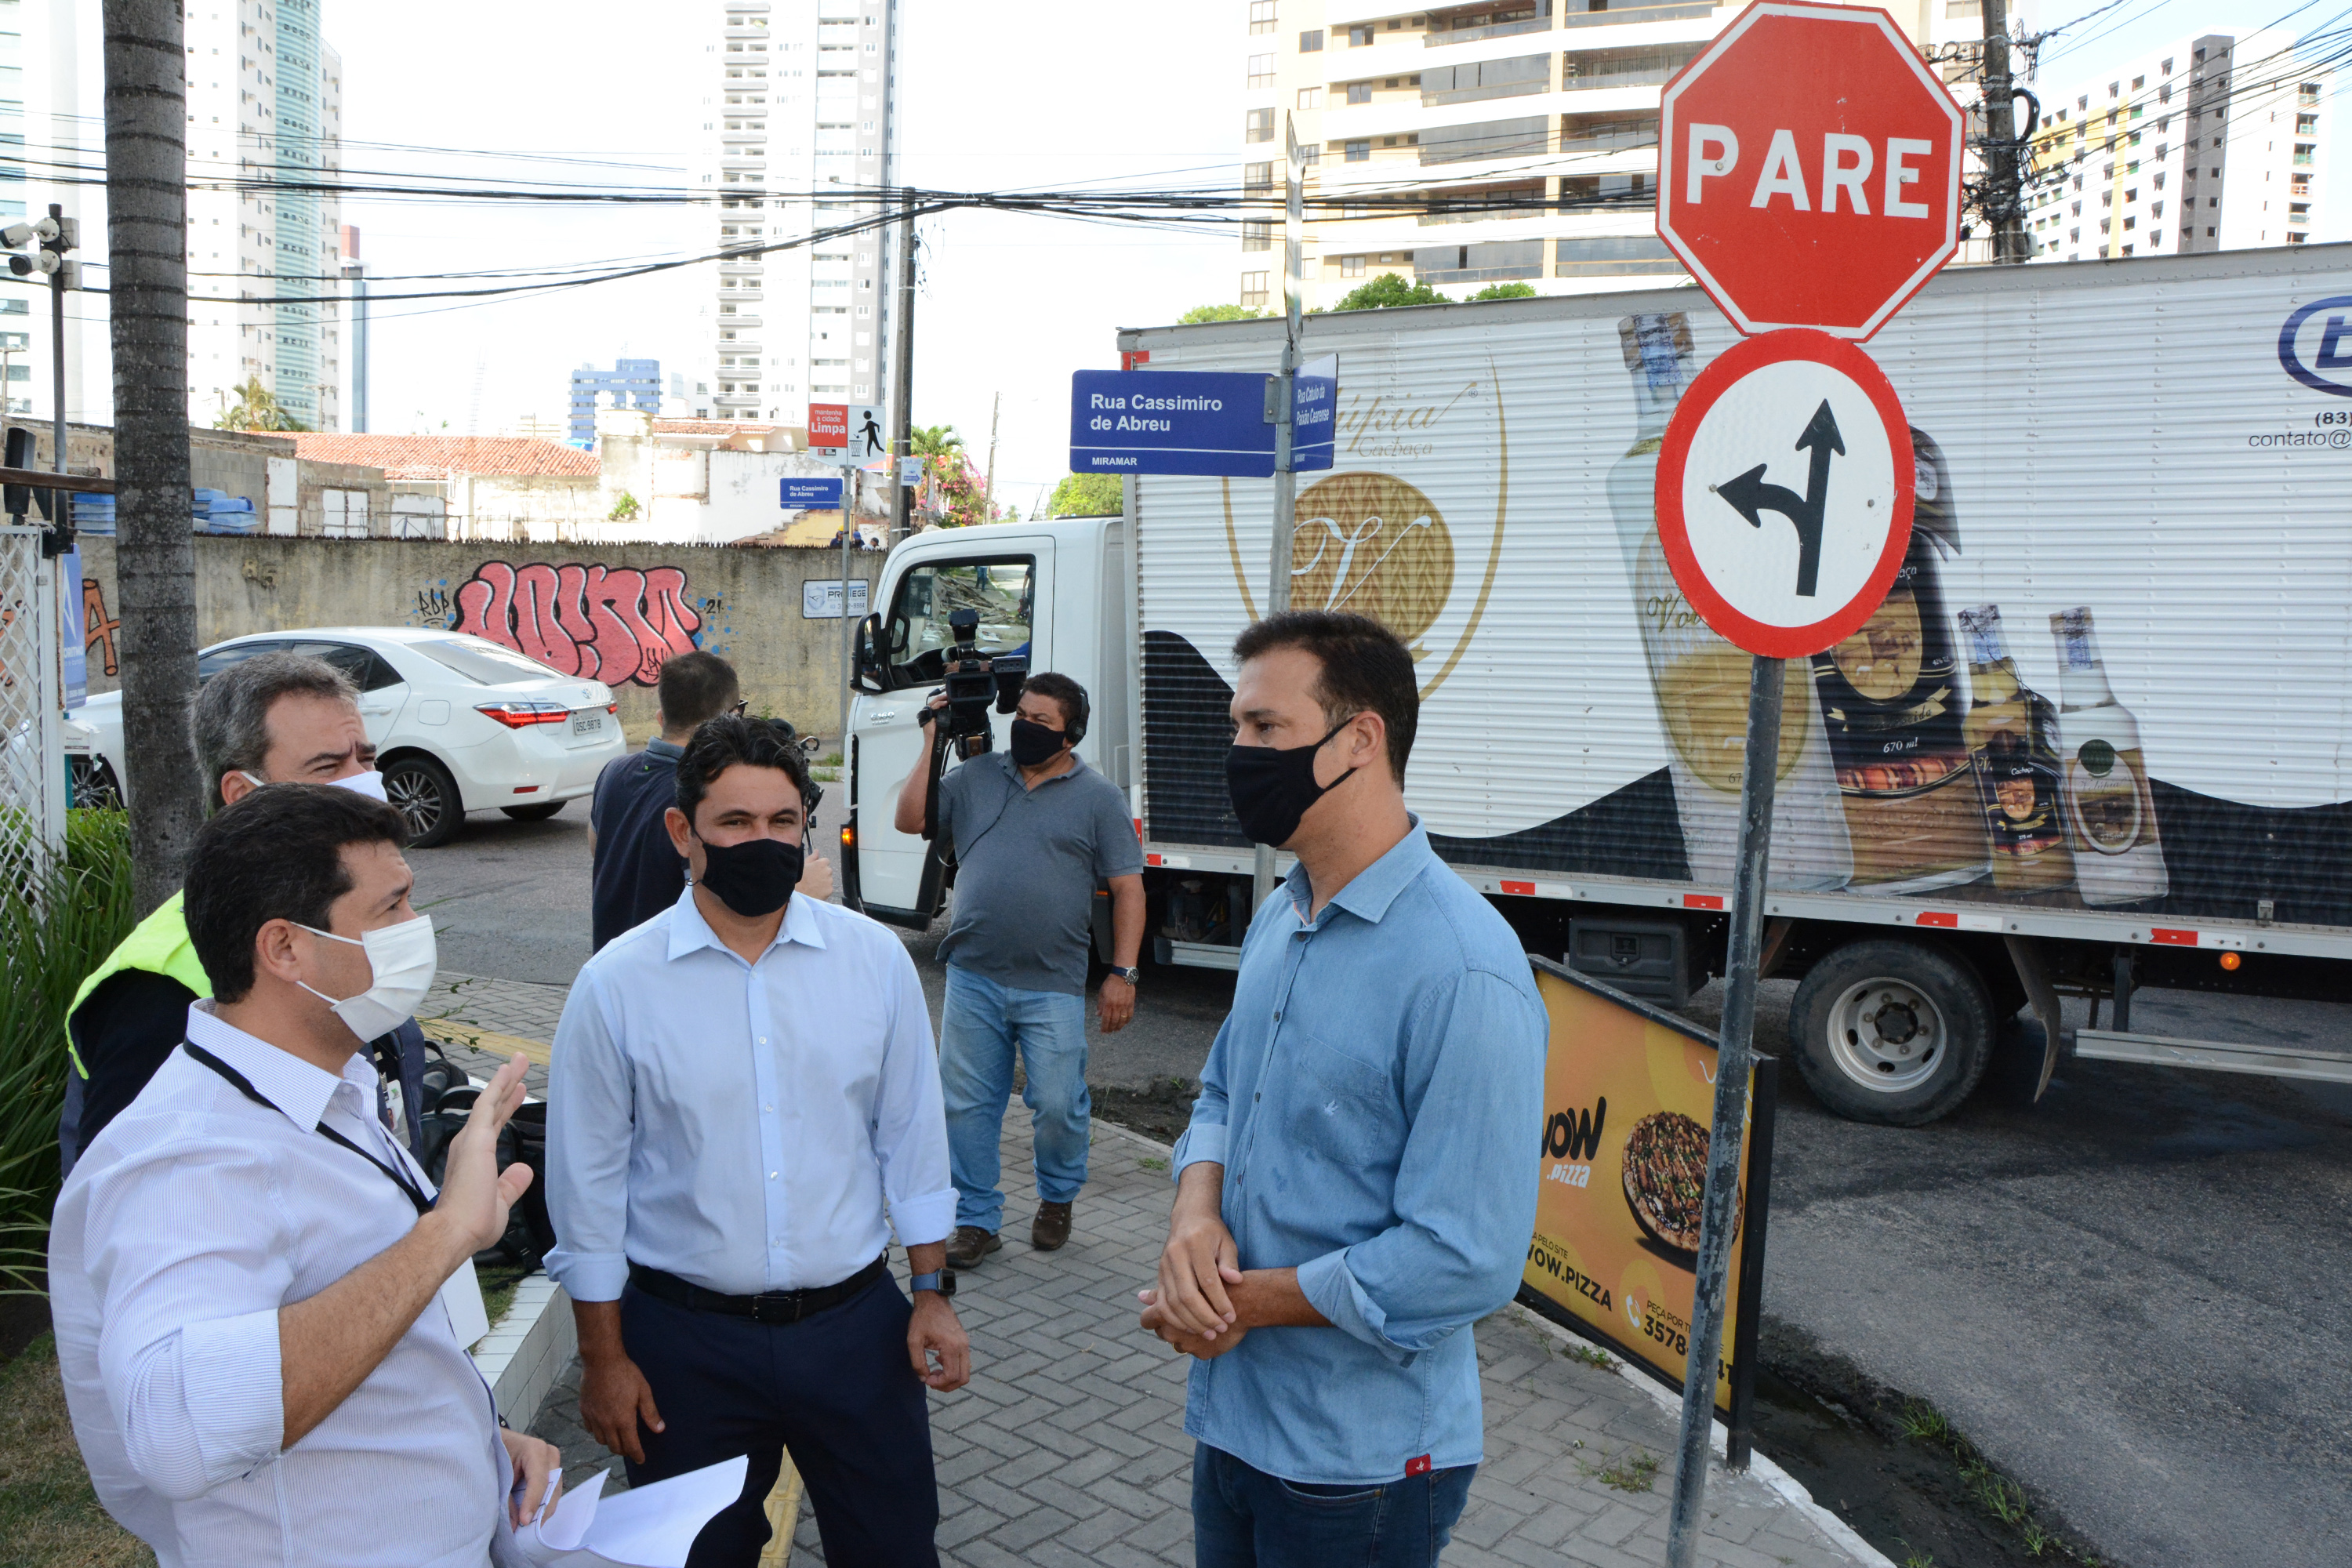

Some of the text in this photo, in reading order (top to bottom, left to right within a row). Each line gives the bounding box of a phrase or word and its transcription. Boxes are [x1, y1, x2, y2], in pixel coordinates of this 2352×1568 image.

[1686, 122, 1933, 219] PARE
[1298, 383, 1326, 404] Rua Catulo da
[1091, 394, 1223, 411] Rua Cassimiro
[1091, 416, 1171, 431] de Abreu
[1296, 408, 1330, 426] Paixão Cearense
[811, 422, 846, 436] Limpa
[1358, 437, 1432, 459] Cachaça
[1091, 457, 1138, 466] MIRAMAR
[827, 588, 866, 598] PRTEGE
[1883, 737, 1918, 753] 670 ml
[1538, 1234, 1554, 1250] PELO
[1555, 1244, 1569, 1260] SITE
[1646, 1300, 1684, 1329] PEÇA POR
